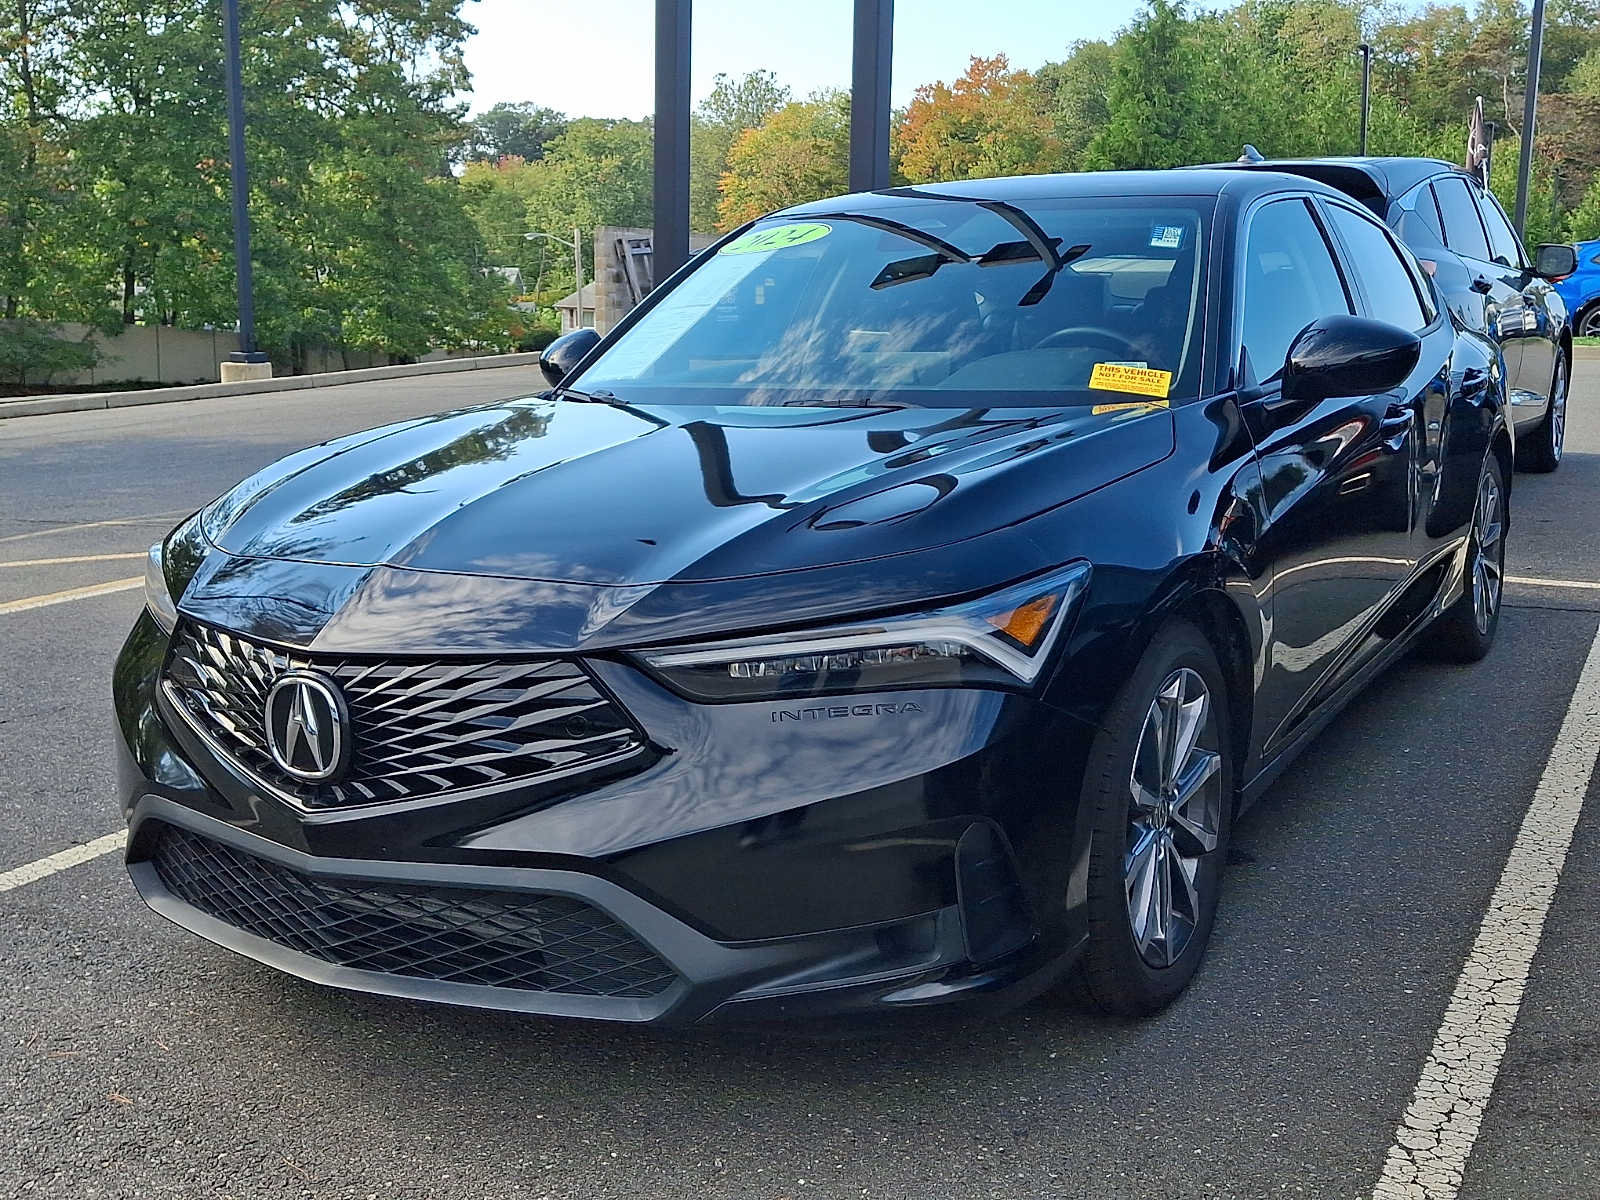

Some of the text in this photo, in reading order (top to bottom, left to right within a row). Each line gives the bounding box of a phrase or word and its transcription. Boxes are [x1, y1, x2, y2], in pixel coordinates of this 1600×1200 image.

[729, 227, 820, 251] 2024
[1099, 365, 1166, 379] THIS VEHICLE
[1139, 376, 1162, 384] SALE
[771, 702, 923, 723] INTEGRA
